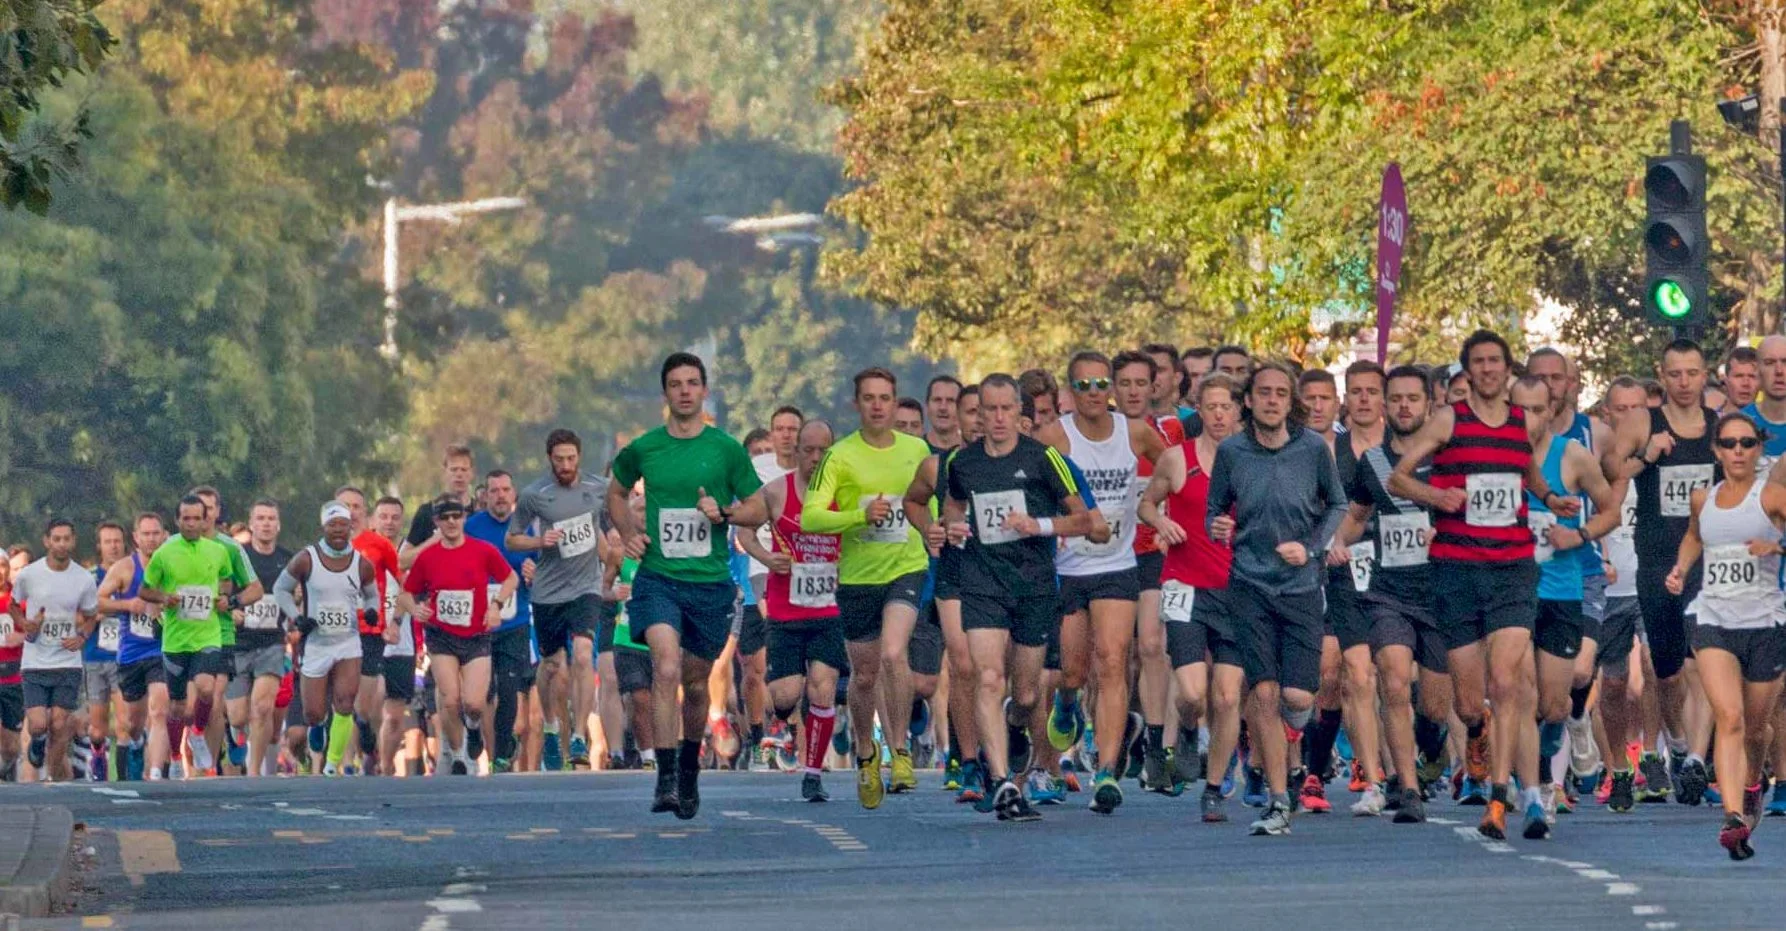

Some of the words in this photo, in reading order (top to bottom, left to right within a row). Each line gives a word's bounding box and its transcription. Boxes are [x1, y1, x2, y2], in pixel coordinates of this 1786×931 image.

[1471, 488, 1515, 510] 4921
[984, 504, 1013, 527] 25
[561, 523, 592, 546] 2668
[663, 522, 707, 543] 5216
[1707, 561, 1755, 585] 5280
[797, 576, 836, 596] 1833
[180, 595, 210, 610] 1742
[247, 604, 278, 619] 4320
[439, 600, 470, 616] 3632
[318, 611, 348, 626] 3535
[43, 622, 72, 638] 4879
